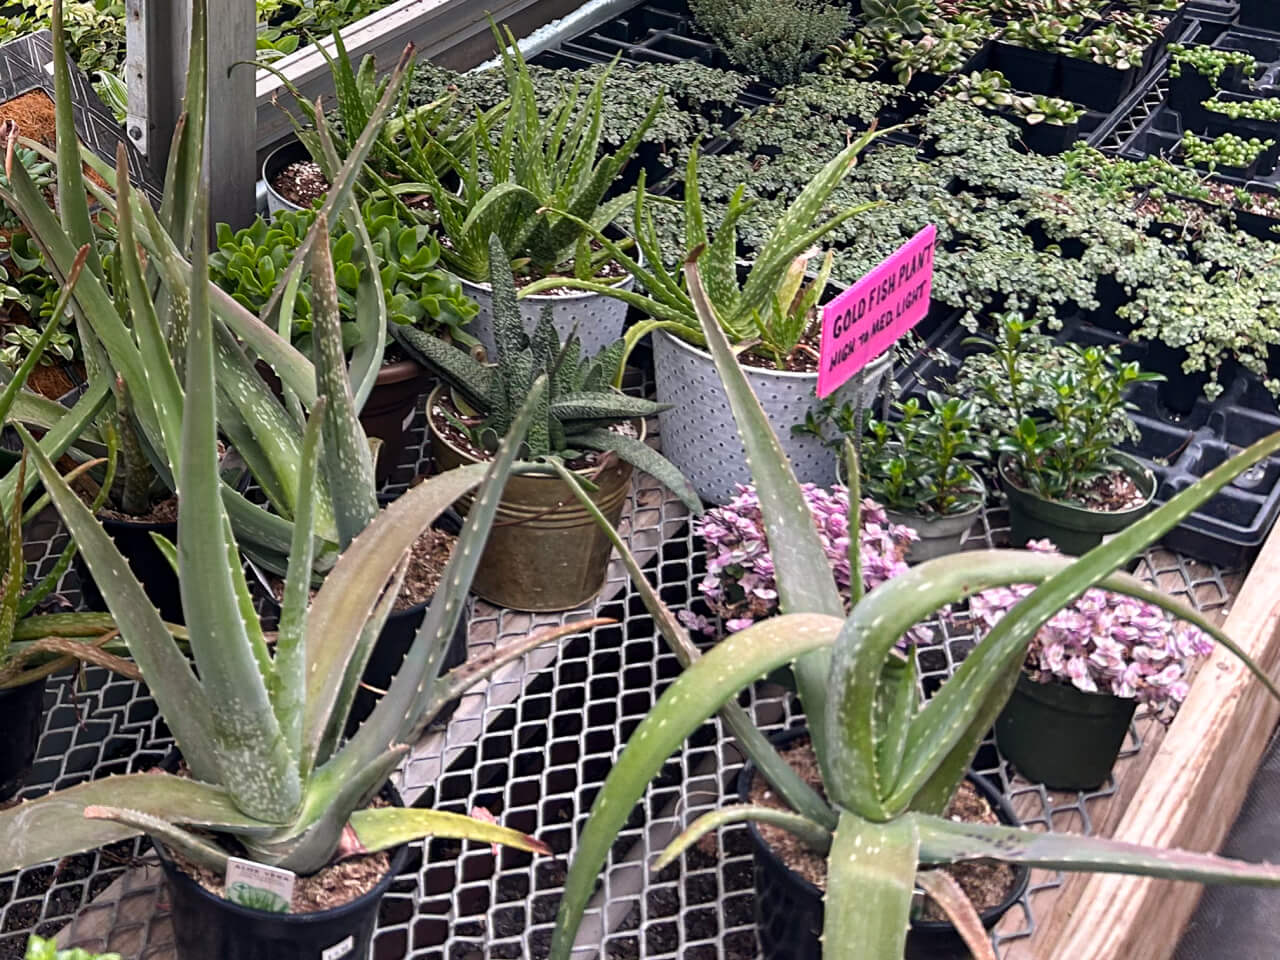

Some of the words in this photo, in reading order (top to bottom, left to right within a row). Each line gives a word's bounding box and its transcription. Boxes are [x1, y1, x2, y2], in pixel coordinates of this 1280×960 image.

[829, 337, 856, 372] HIGH
[895, 279, 927, 319] LIGHT
[832, 297, 867, 339] GOLD
[868, 273, 896, 313] FISH
[898, 241, 934, 288] PLANT
